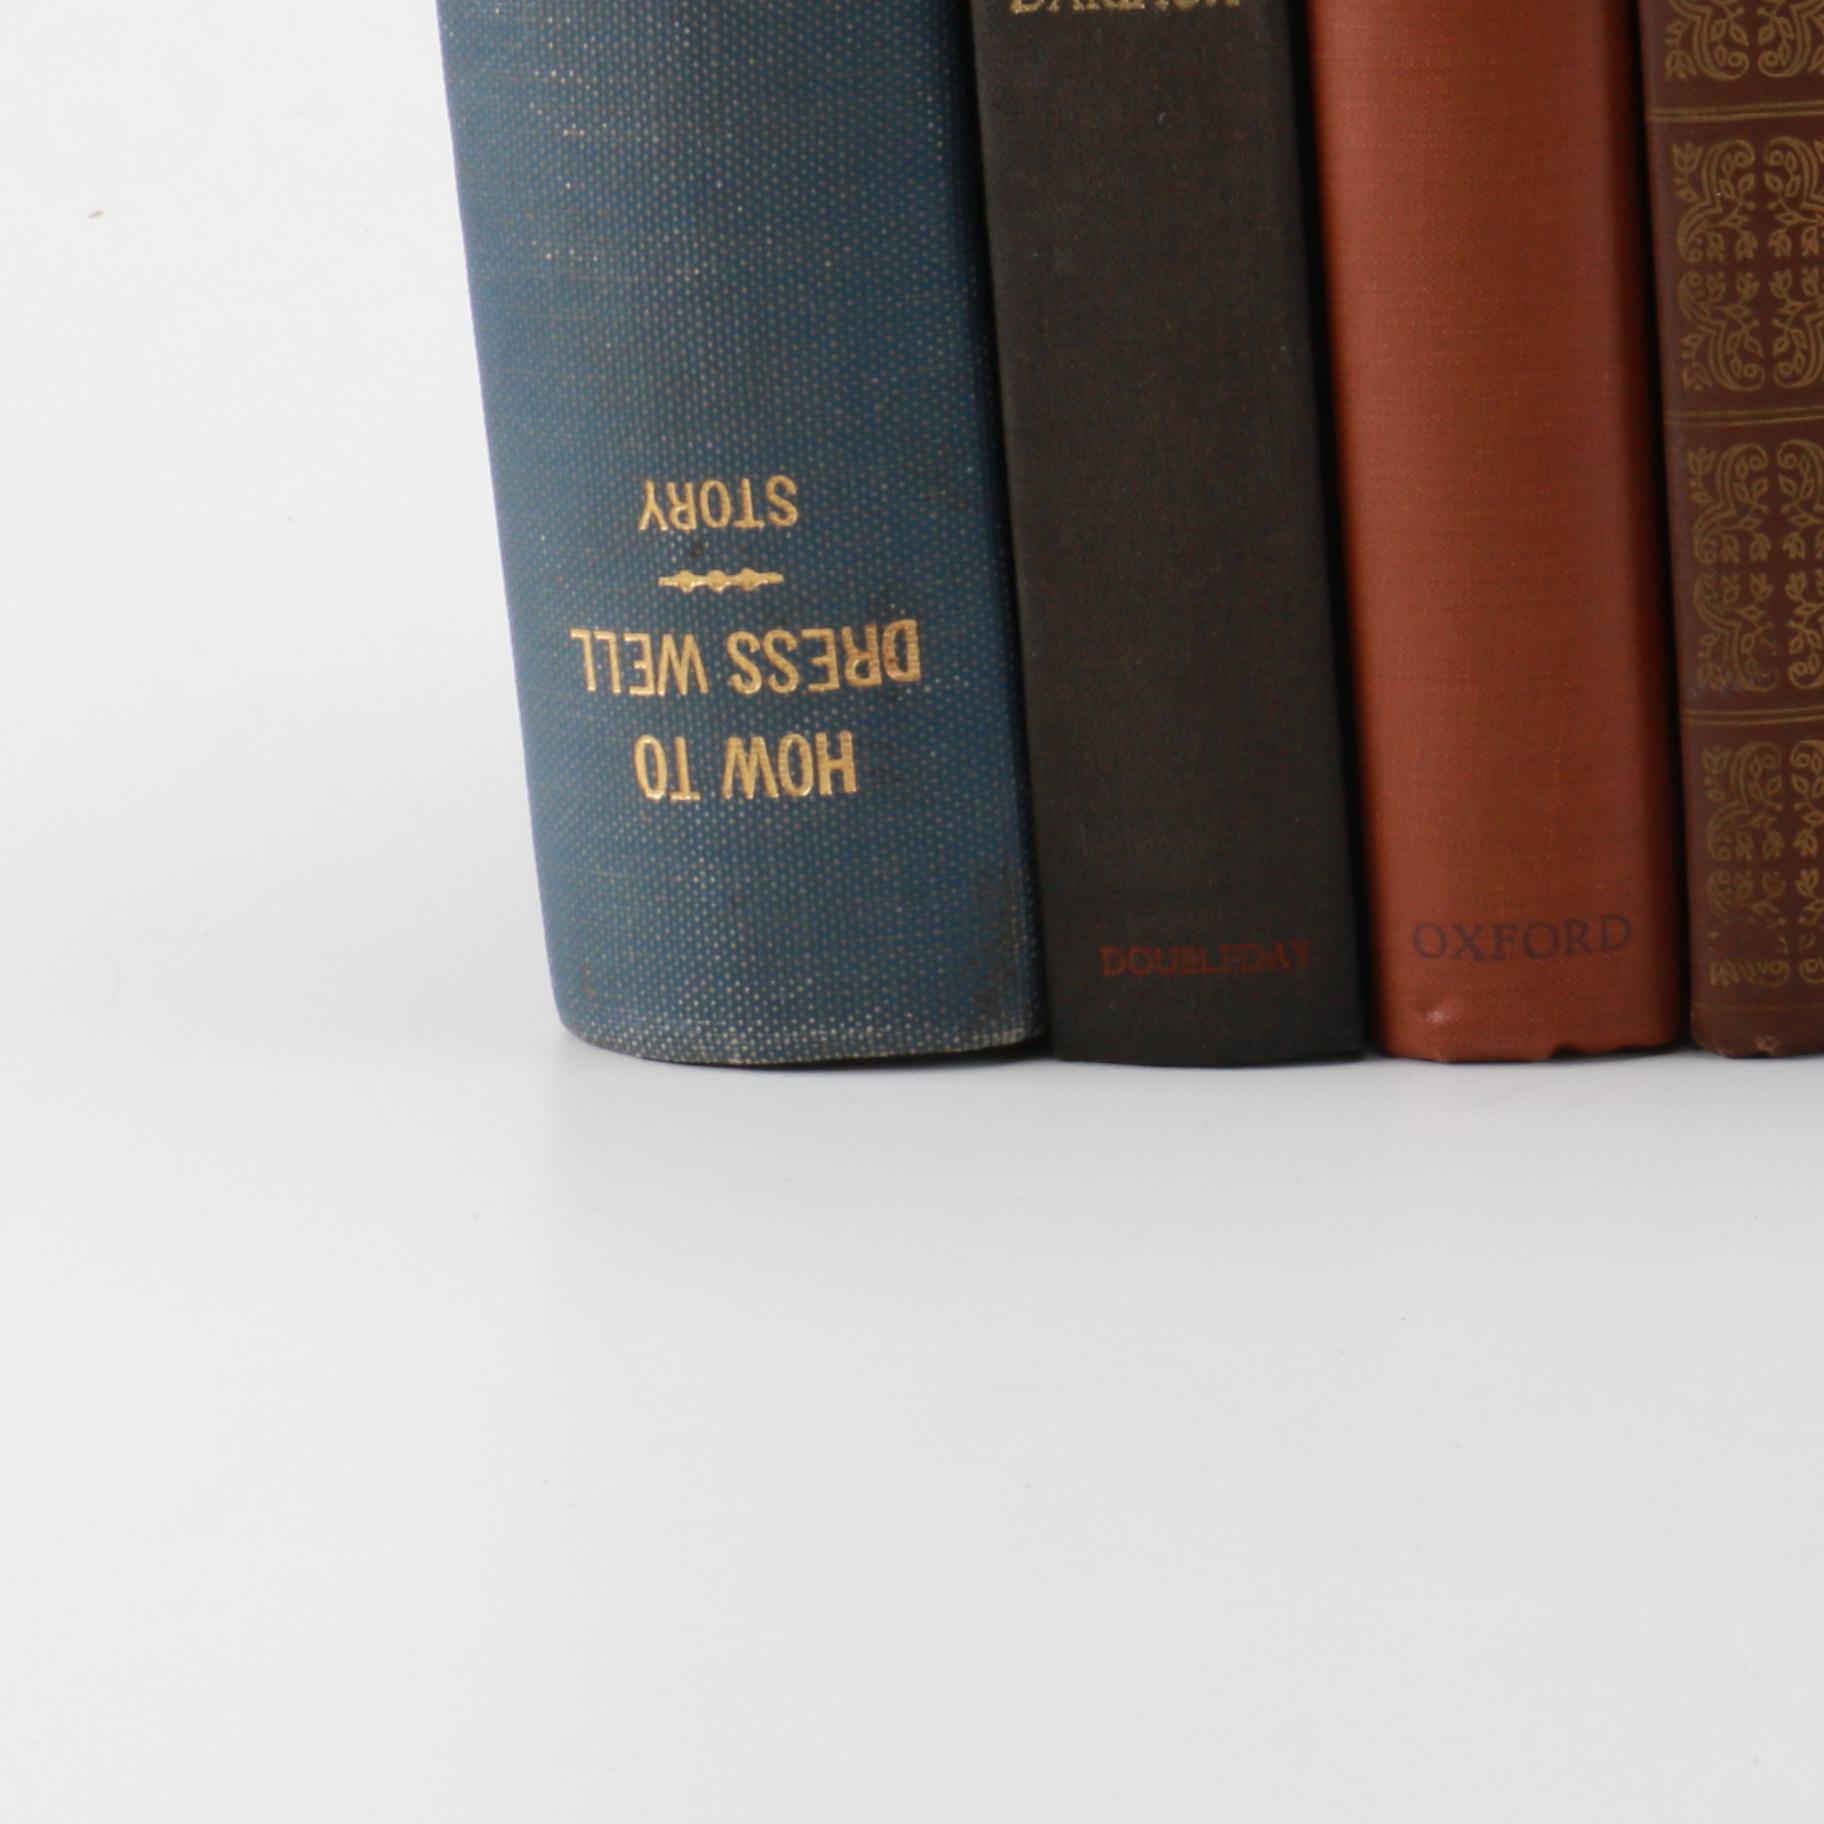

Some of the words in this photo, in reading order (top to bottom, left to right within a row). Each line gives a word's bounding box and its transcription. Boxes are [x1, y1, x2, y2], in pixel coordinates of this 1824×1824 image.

[637, 475, 798, 531] STORY
[570, 628, 709, 696] WELL
[726, 619, 921, 695] DRESS
[633, 733, 701, 801] TO
[721, 730, 857, 800] HOW
[1100, 939, 1314, 976] DOUBLEDAY
[1413, 913, 1632, 962] OXFORD
